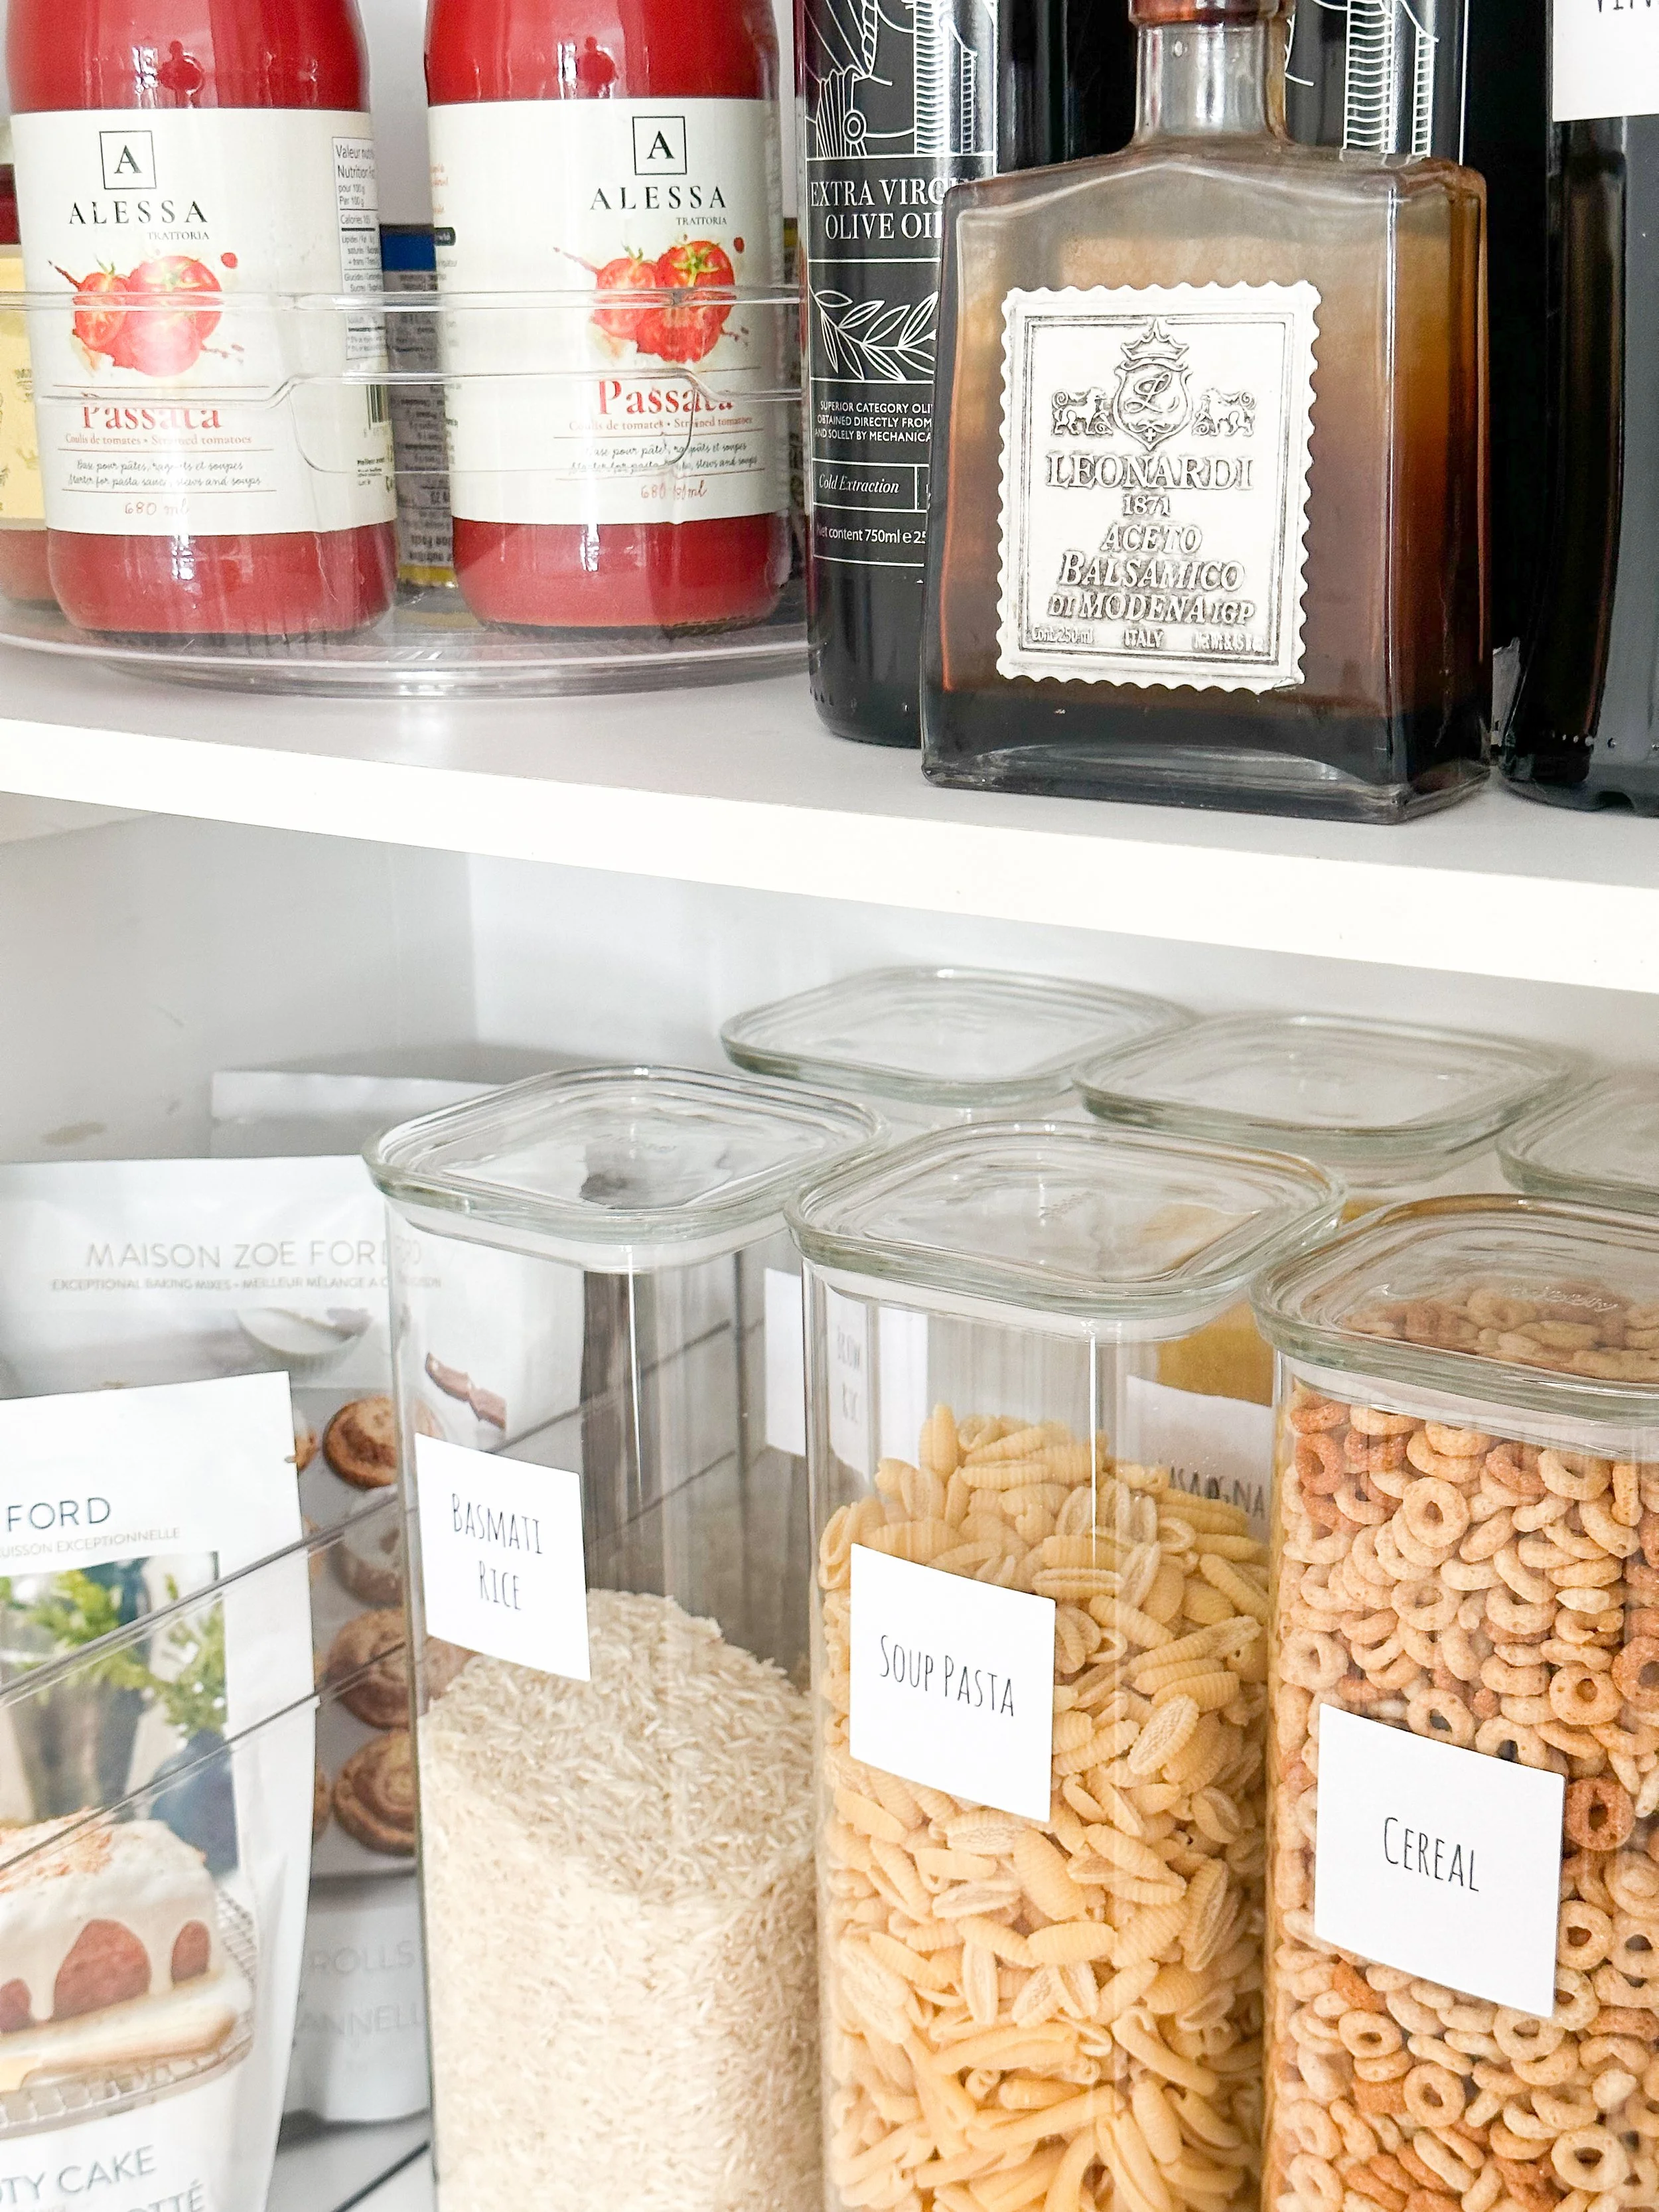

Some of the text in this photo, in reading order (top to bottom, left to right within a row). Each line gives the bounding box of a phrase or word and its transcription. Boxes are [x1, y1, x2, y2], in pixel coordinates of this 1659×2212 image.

[646, 130, 674, 159] A
[114, 145, 142, 174] A
[590, 185, 727, 210] ALESSA
[810, 180, 876, 206] EXTRA
[68, 200, 208, 224] ALESSA
[676, 216, 727, 226] TRATTORIA
[147, 230, 210, 242] TRATTORIA
[825, 212, 895, 240] OLIVE
[820, 400, 854, 411] SUPERIOR
[856, 402, 908, 414] CATEGORY
[607, 419, 618, 430] de
[817, 414, 932, 429] OBTAINED DIRECTLY FROM
[90, 434, 100, 444] de
[103, 435, 141, 445] tomates
[202, 435, 252, 445] tomatoes
[828, 429, 854, 440] SOLELY
[856, 430, 867, 441] BY
[97, 462, 117, 474] pour
[205, 475, 228, 486] and
[1046, 452, 1255, 490] LEONARDI
[819, 473, 900, 494] Cold Extraction
[125, 502, 157, 516] 680
[1122, 493, 1171, 517] 1871
[829, 527, 863, 542] content
[865, 528, 901, 544] 750ml
[1100, 522, 1203, 554] ACETO
[1058, 548, 1246, 592] BALSAMICO
[1048, 592, 1256, 625] DI MODENA IGP
[1056, 627, 1079, 644] 250
[1124, 628, 1165, 648] ITALY
[87, 1242, 222, 1268] MAISON
[234, 1240, 295, 1270] ZOE
[7, 1496, 111, 1532] FORD
[451, 1493, 543, 1555] BASMATI
[56, 1527, 181, 1553] EXCEPTIONNELLE
[478, 1560, 522, 1611] RICE
[879, 1634, 1014, 1717] SOUP PASTA
[1384, 1816, 1480, 1892] CEREAL
[0, 2144, 157, 2204] TY CAKE
